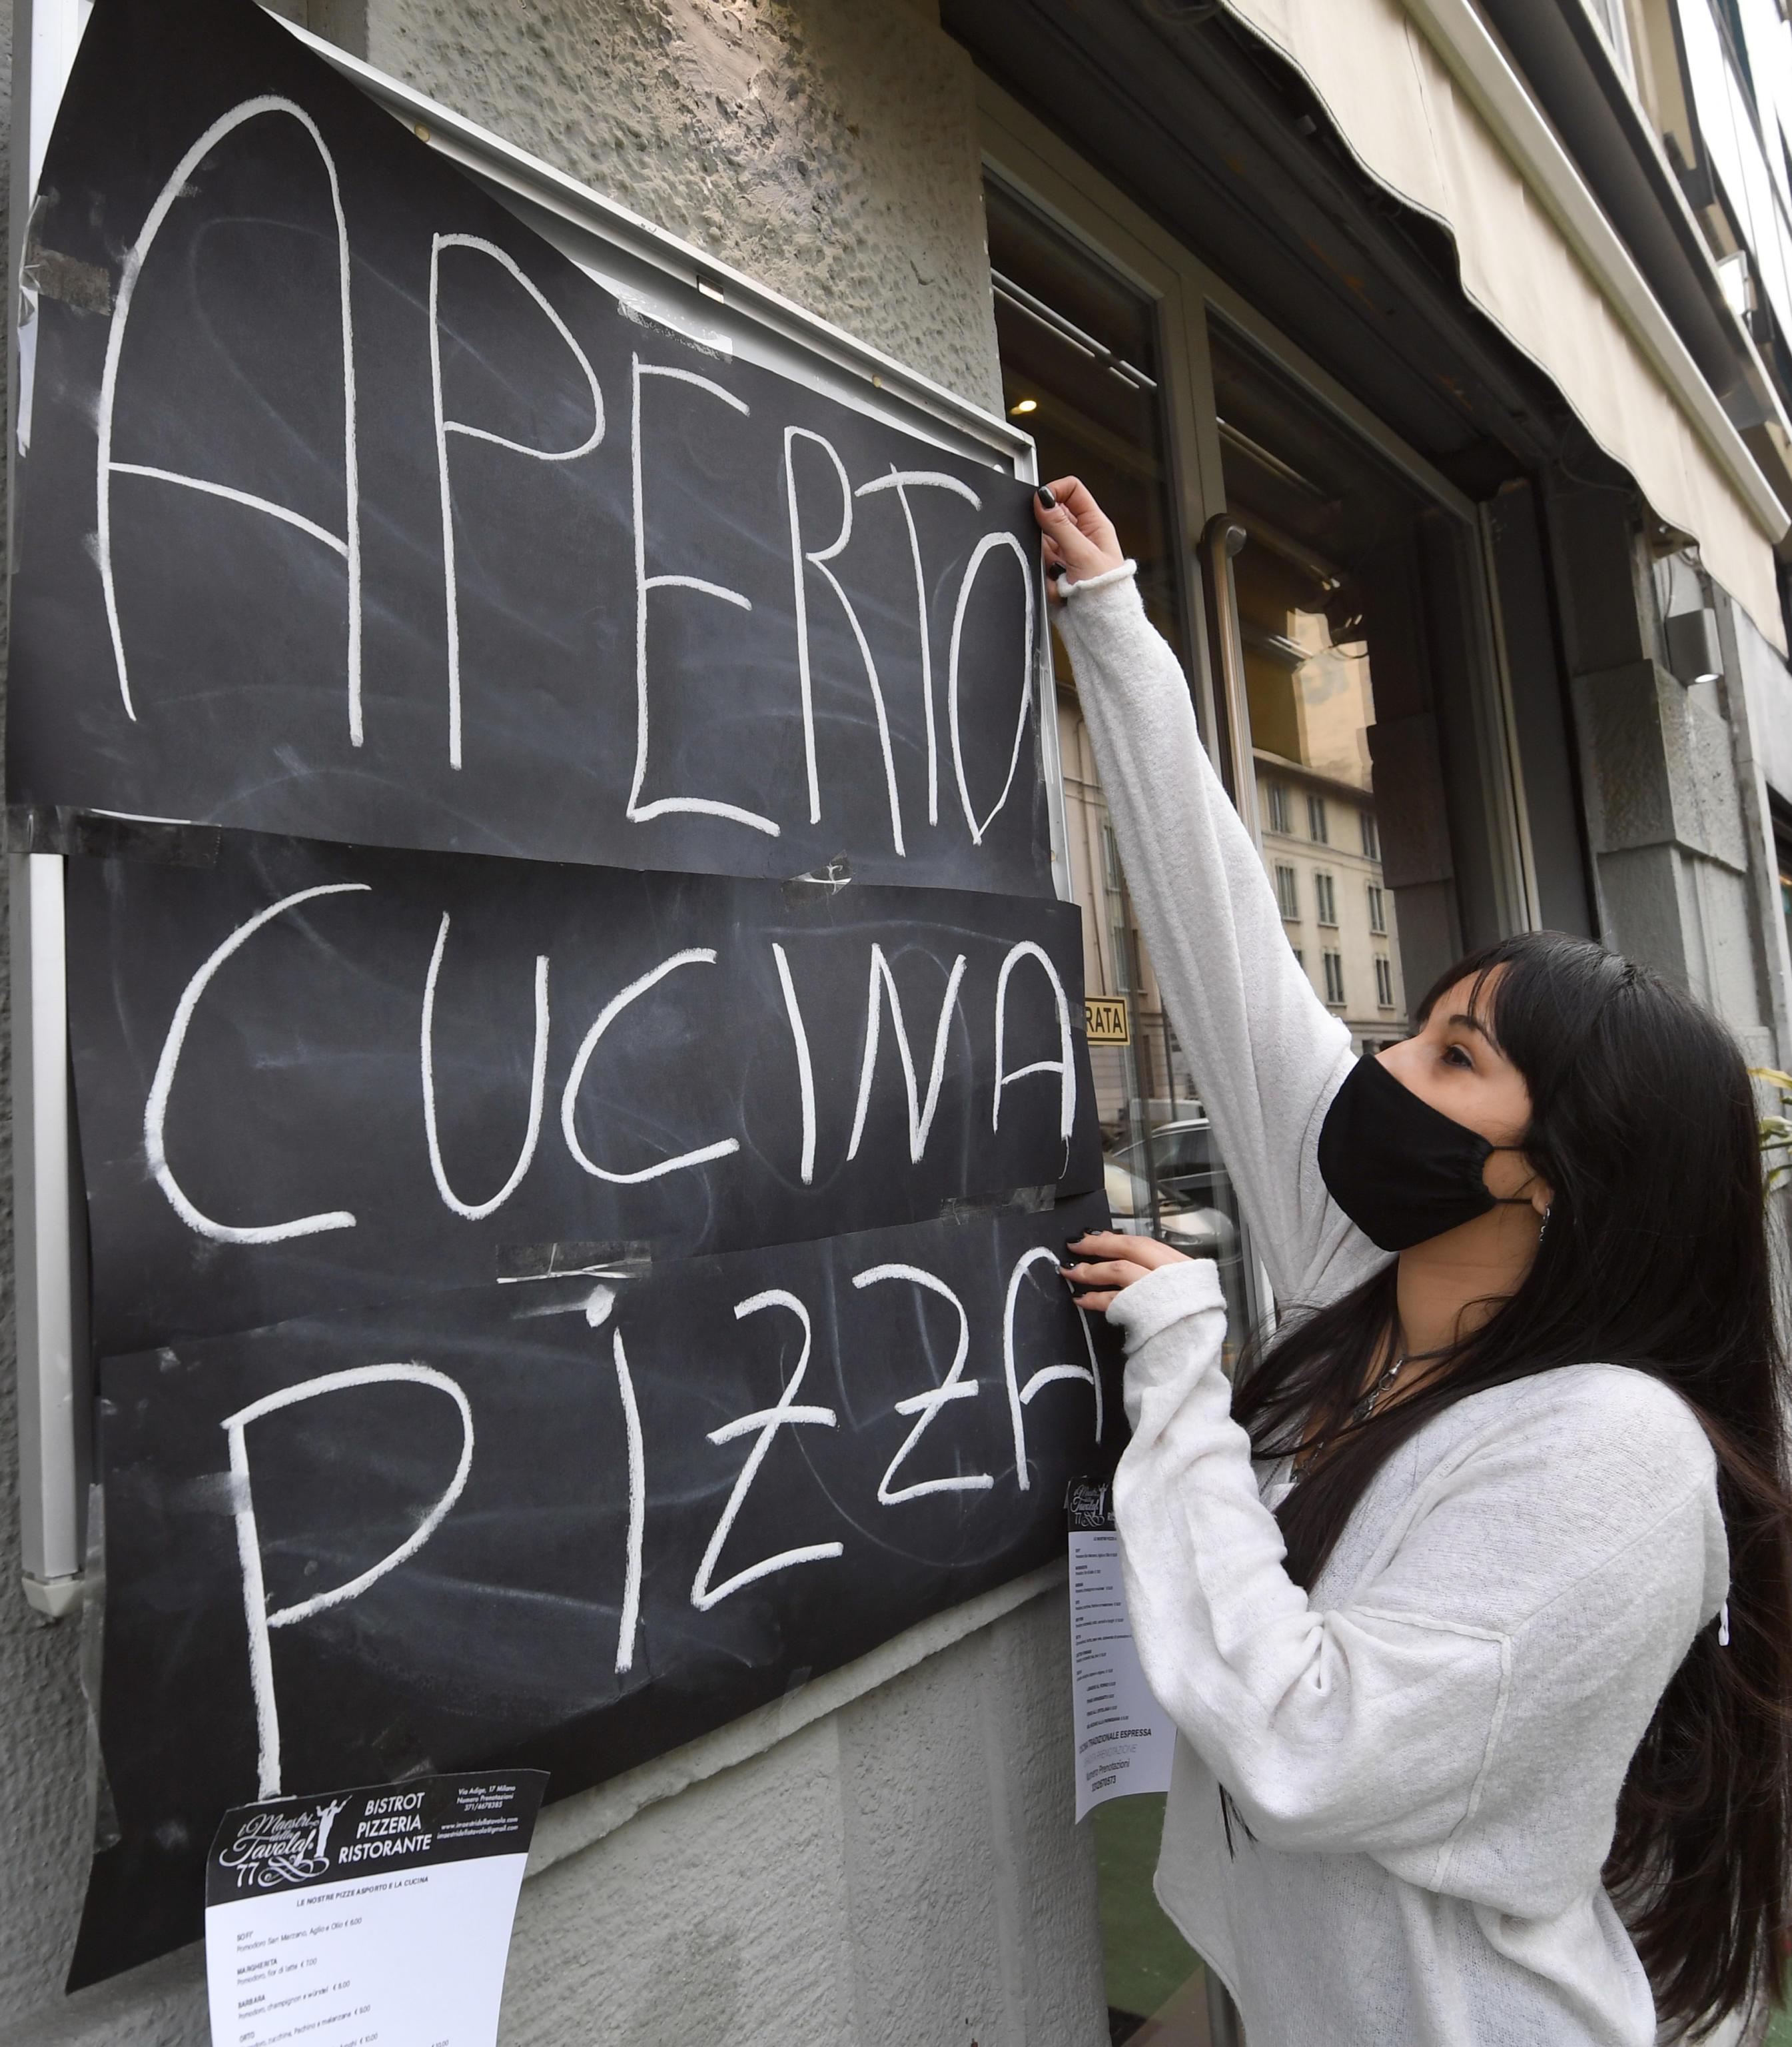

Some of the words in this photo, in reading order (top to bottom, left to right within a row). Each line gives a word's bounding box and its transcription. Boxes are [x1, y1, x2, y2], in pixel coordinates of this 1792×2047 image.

[97, 95, 1035, 858] APERTO
[145, 882, 1074, 1244] CUCINA
[1120, 1728, 1152, 1738] ESPRESSA
[1099, 1758, 1130, 1773] Prenotazioni
[364, 1792, 426, 1816] BISTROT
[356, 1813, 422, 1840] PIZZERIA
[219, 1832, 305, 1866] Tavola
[338, 1833, 433, 1864] RISTORANTE
[236, 1861, 260, 1888] 77
[296, 1898, 306, 1908] LE
[306, 1893, 334, 1906] NOSTRE
[335, 1888, 356, 1900] PIZZE
[356, 1882, 388, 1896] ASPORTO
[394, 1880, 402, 1889] LA
[404, 1876, 429, 1887] CUCINA
[309, 1924, 325, 1936] Aglio
[330, 1920, 344, 1930] Olio
[236, 1958, 278, 1976] MARGHERITA
[237, 1994, 266, 2010] BARBARA
